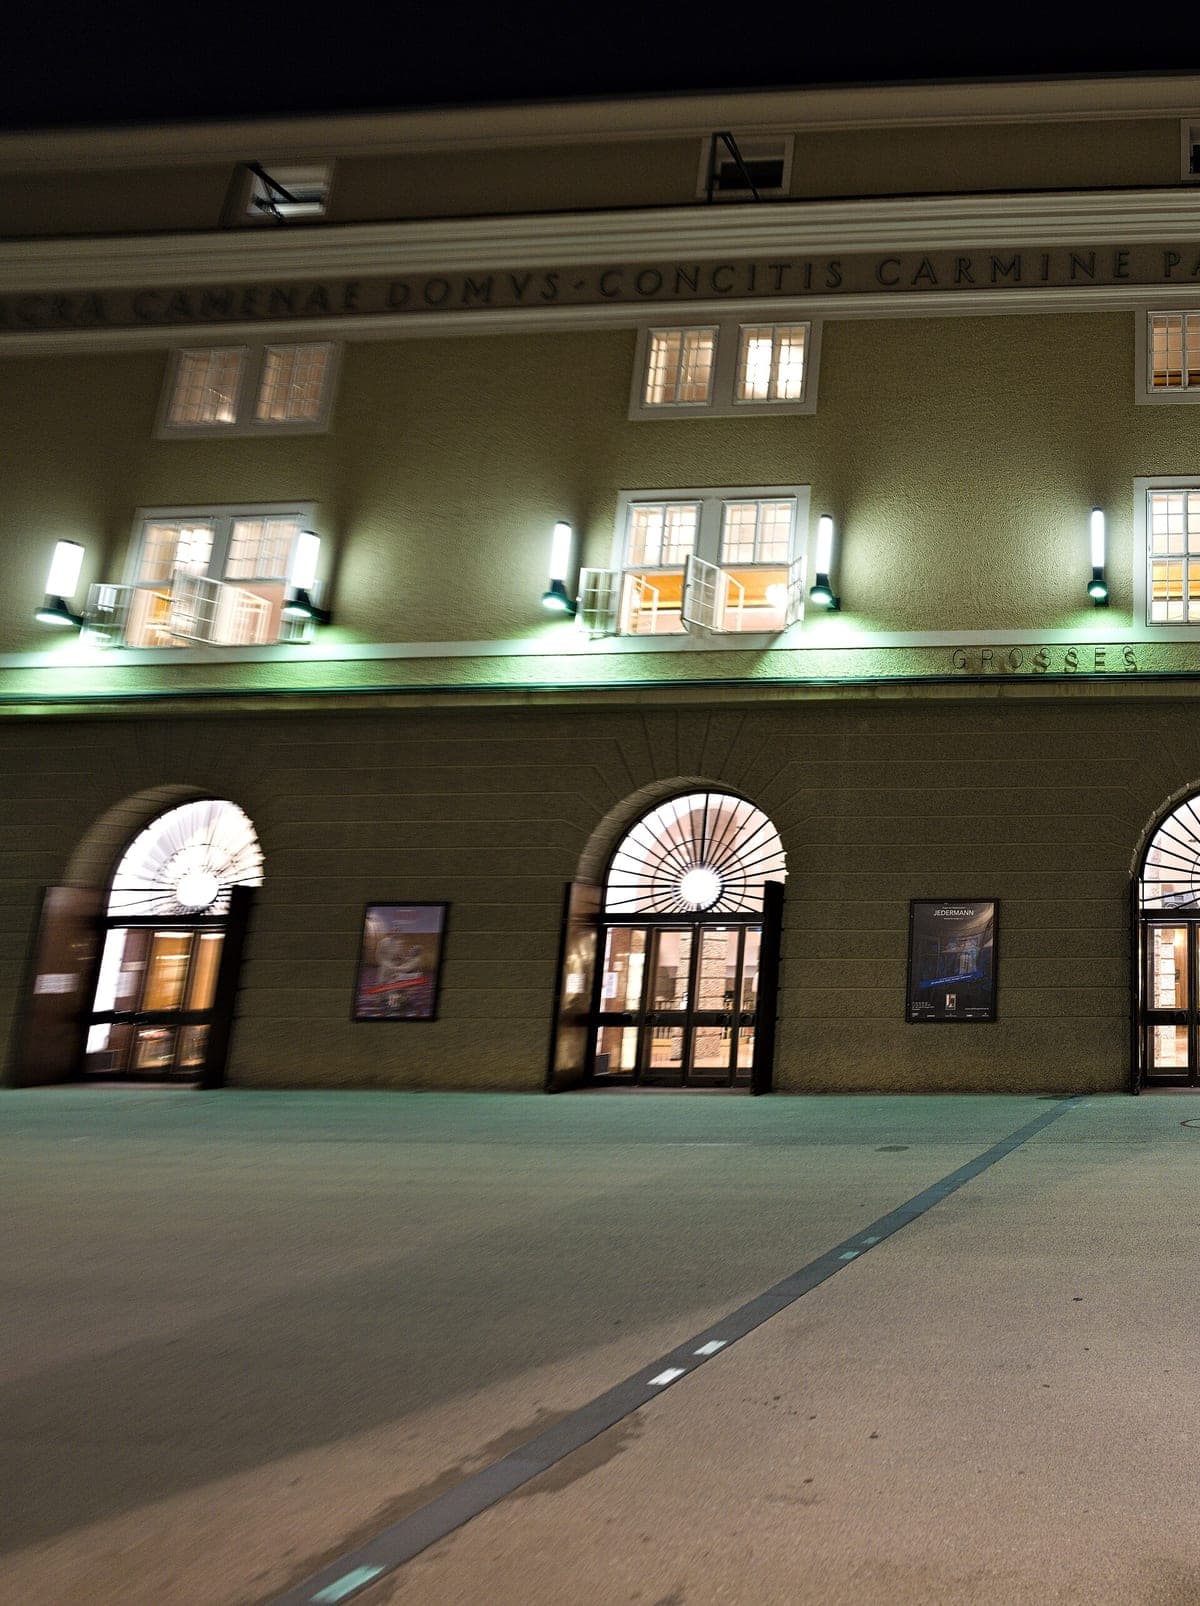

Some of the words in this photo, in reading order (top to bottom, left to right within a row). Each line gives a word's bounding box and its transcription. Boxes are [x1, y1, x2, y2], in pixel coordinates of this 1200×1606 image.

[386, 273, 559, 308] DOMVS
[600, 258, 843, 298] CONCITIS
[875, 249, 1131, 286] CARMINE
[952, 645, 1136, 671] GROSSES
